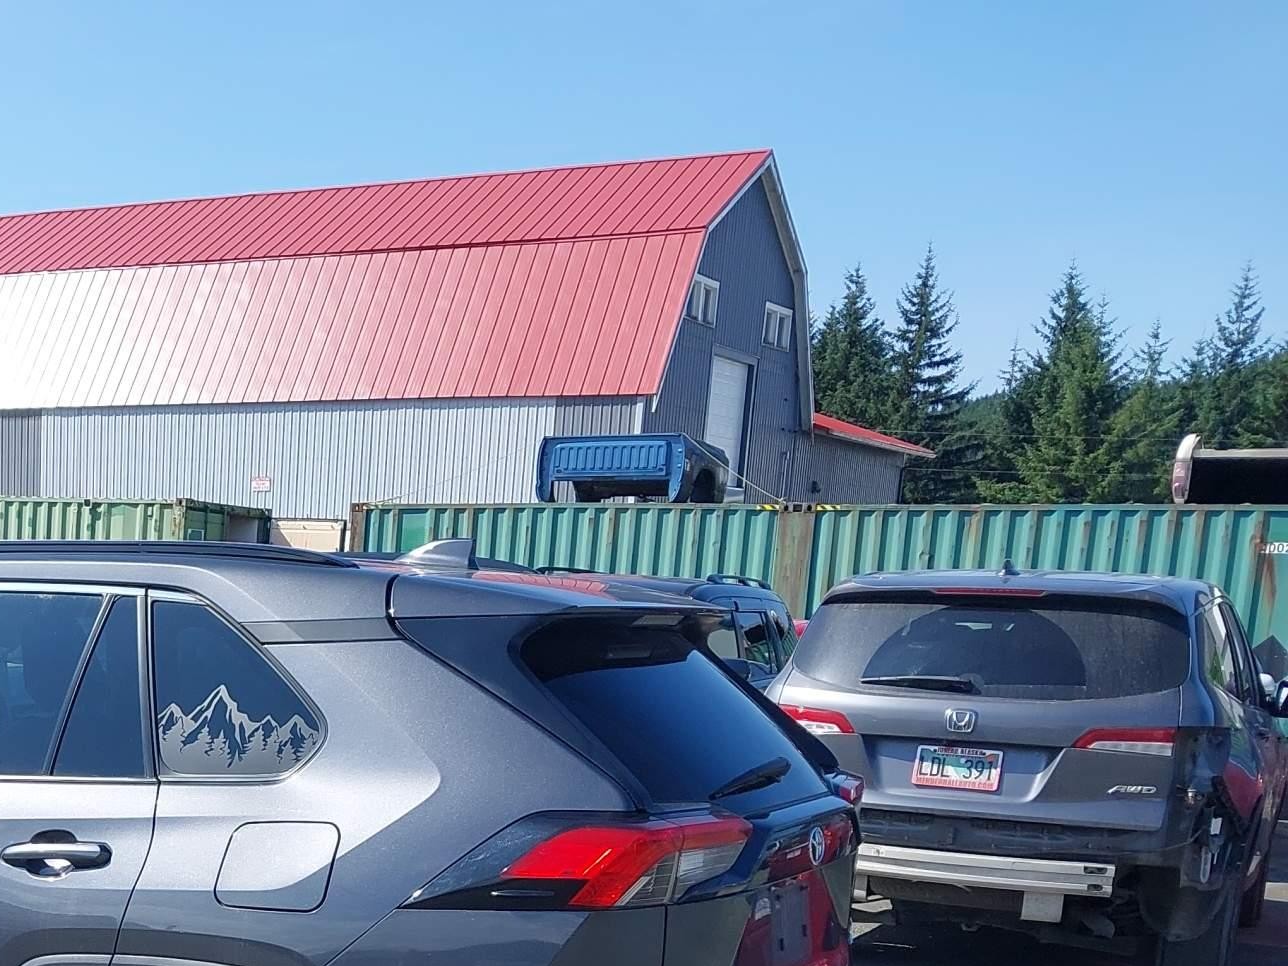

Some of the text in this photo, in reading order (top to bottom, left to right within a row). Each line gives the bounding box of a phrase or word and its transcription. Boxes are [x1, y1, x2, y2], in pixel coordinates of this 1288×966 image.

[919, 755, 994, 781] LDL 391
[1106, 785, 1157, 794] AWD
